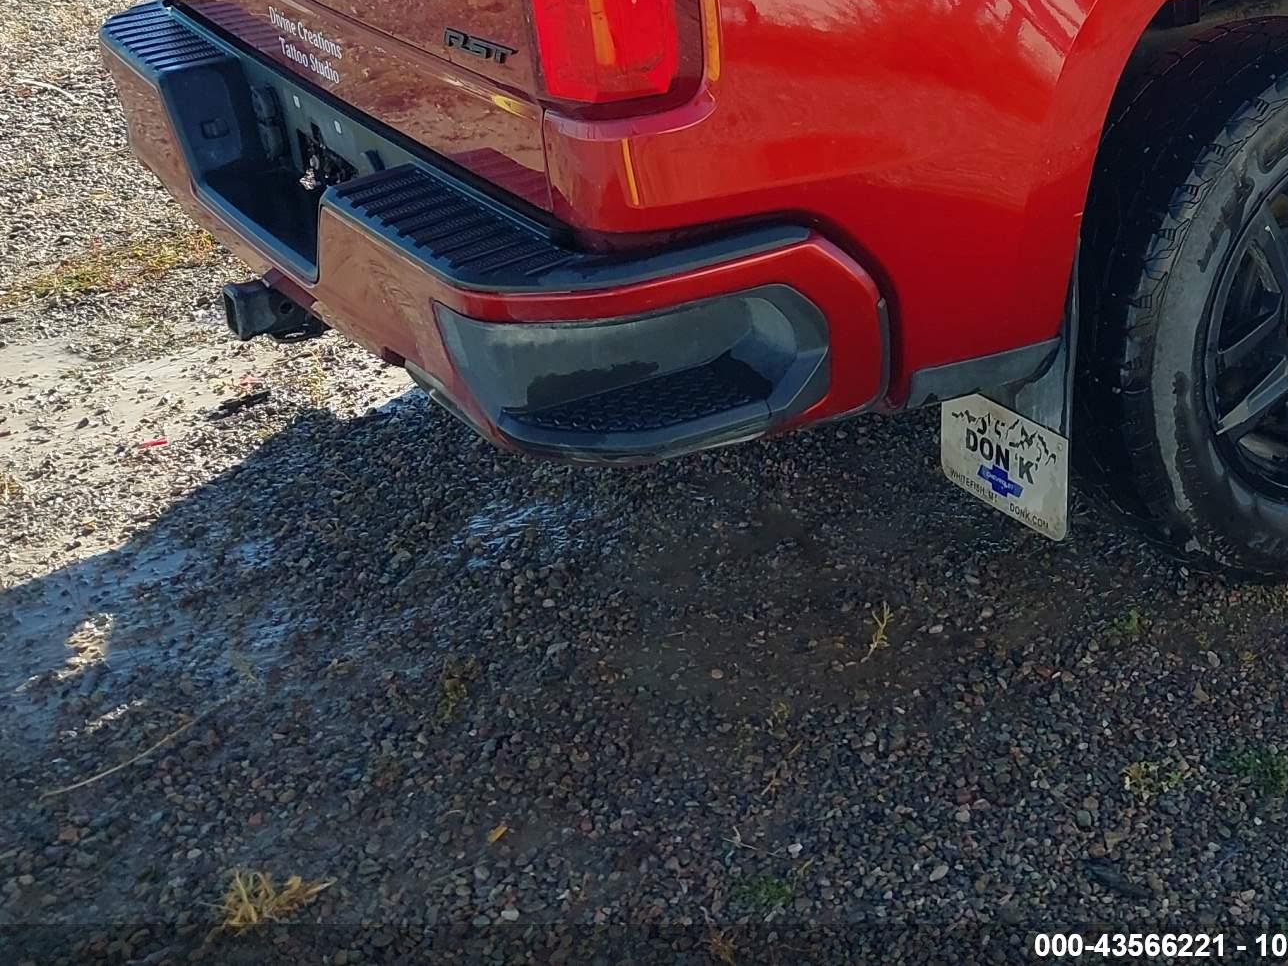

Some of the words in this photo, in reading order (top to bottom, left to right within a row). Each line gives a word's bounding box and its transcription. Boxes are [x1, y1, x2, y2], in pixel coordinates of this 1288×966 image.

[268, 5, 297, 36] Divine
[296, 21, 343, 60] Creations
[443, 26, 519, 65] RST
[279, 36, 309, 68] Tattoo
[309, 52, 341, 85] Studio
